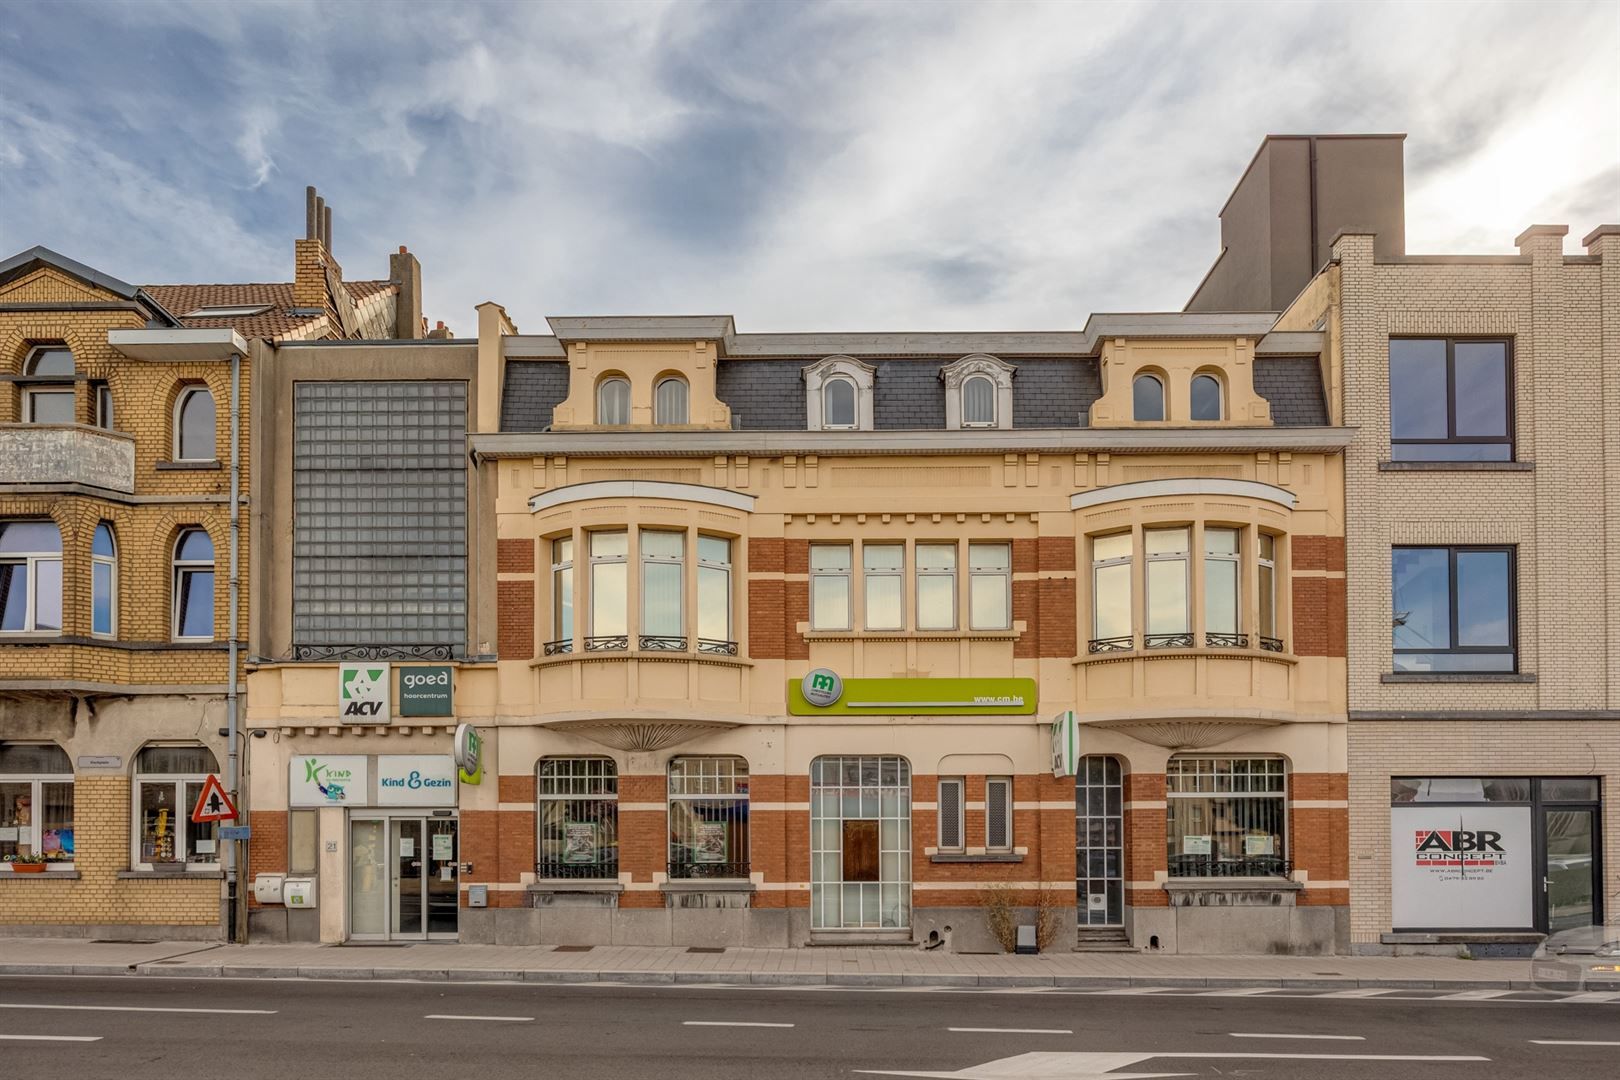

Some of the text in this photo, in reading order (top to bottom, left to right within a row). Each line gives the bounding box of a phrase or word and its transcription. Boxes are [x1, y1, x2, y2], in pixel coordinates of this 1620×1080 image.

[404, 671, 448, 689] goed
[973, 695, 1024, 704] www.cm.be
[344, 701, 383, 716] ACV
[325, 769, 352, 778] KIND
[381, 770, 452, 789] Kind & Gezin
[1416, 830, 1506, 851] ABR
